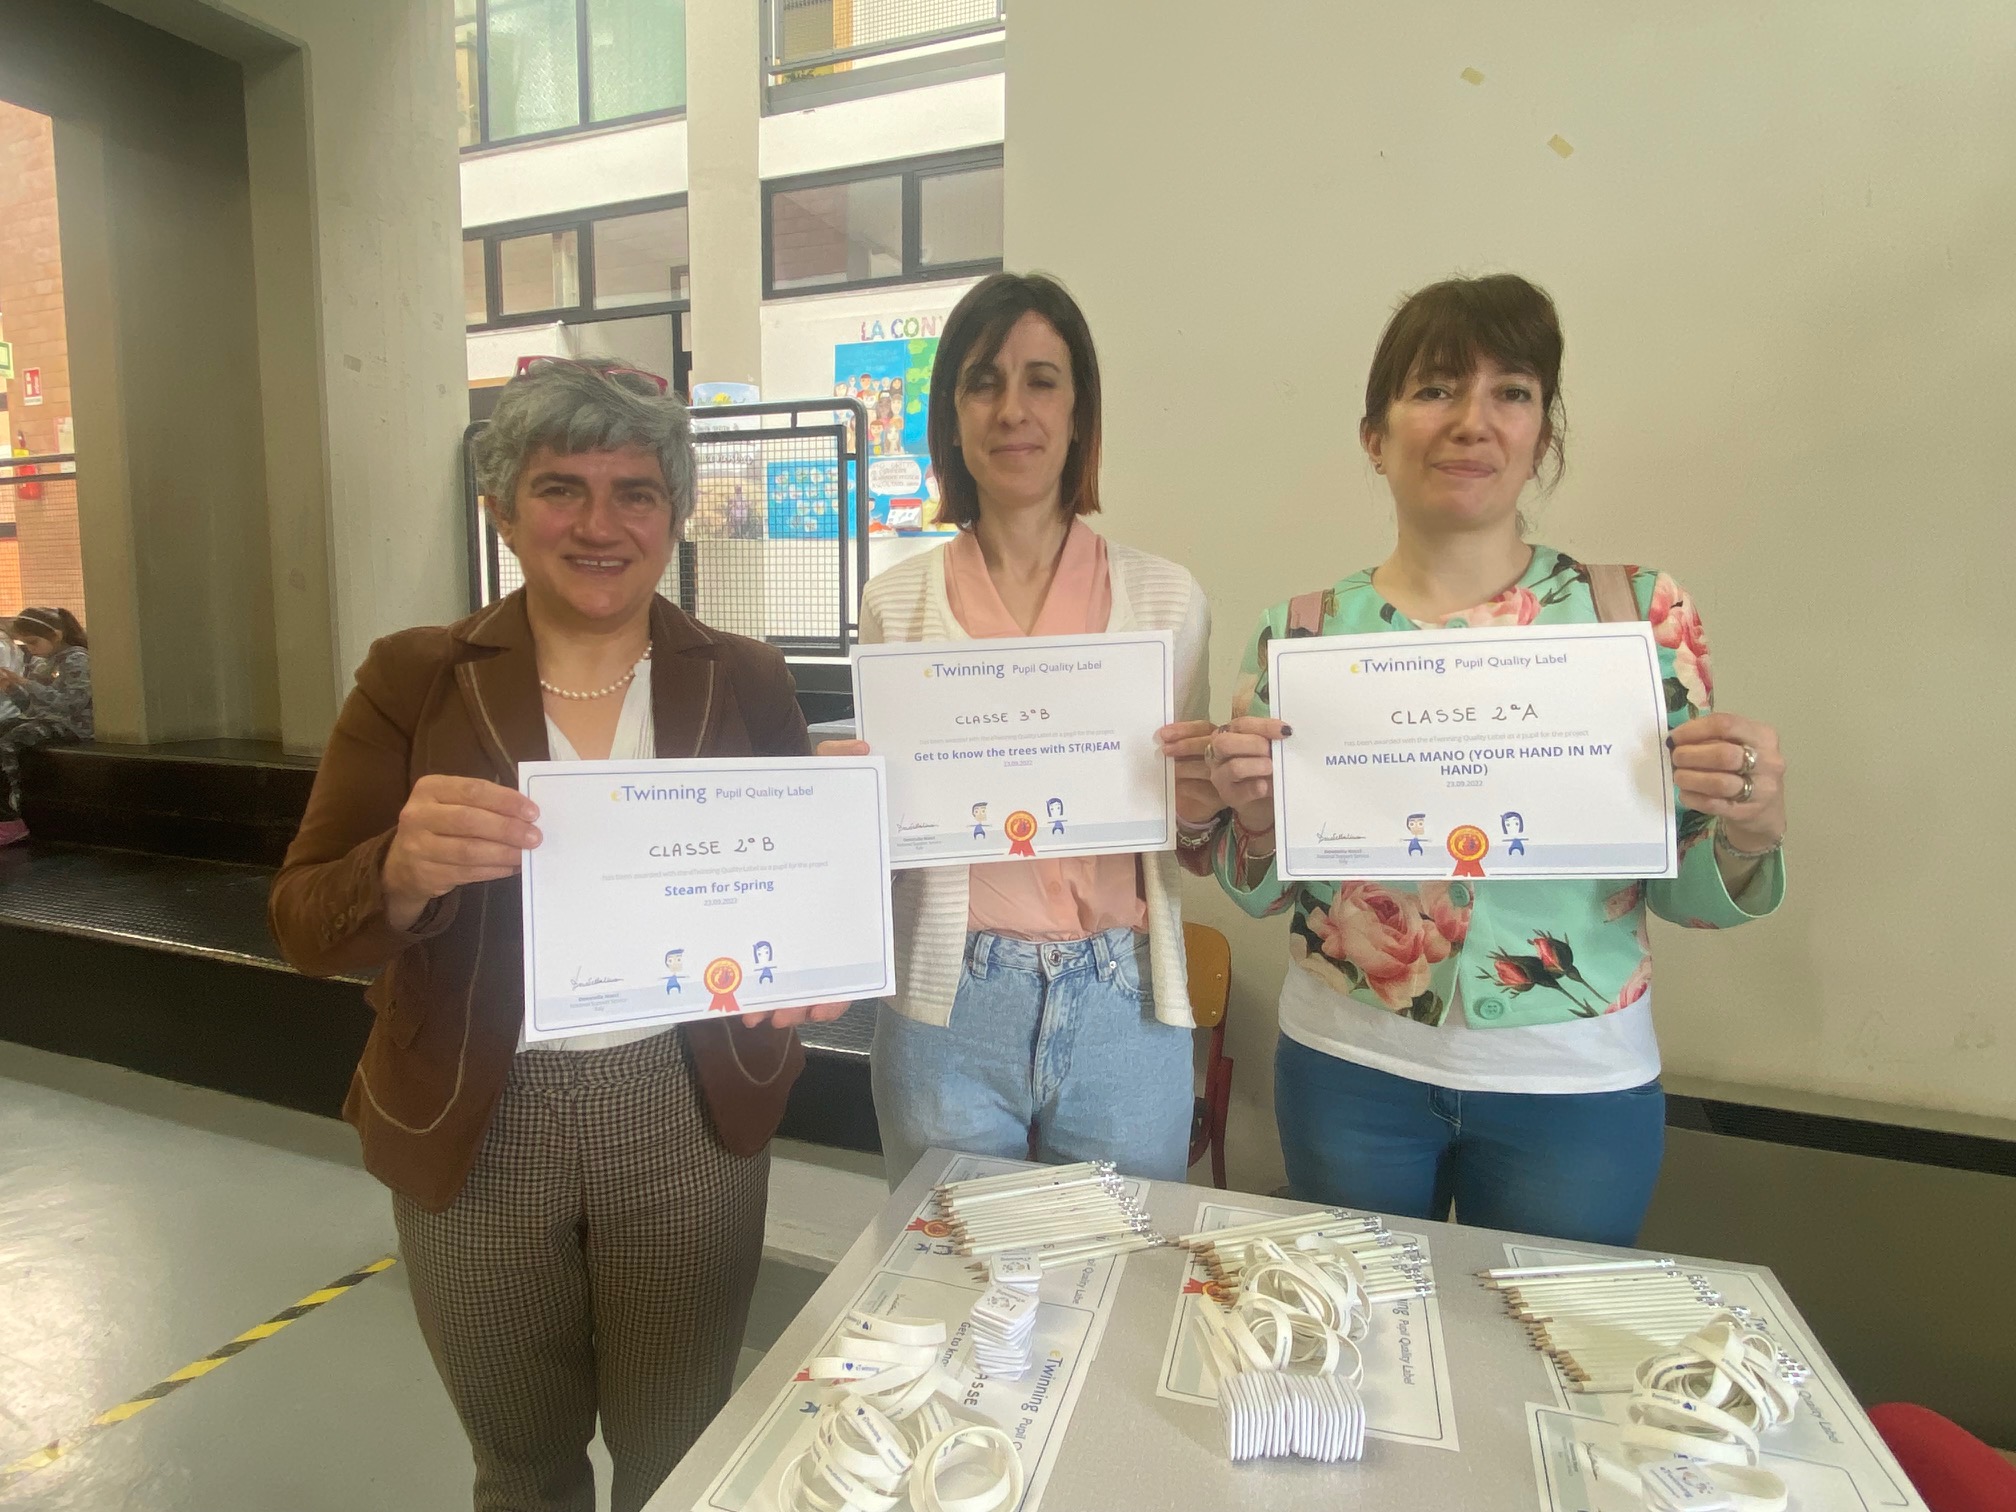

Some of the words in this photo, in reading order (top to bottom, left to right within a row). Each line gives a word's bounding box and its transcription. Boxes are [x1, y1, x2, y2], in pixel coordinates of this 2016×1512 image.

[861, 320, 885, 341] LA
[890, 315, 942, 338] CON
[923, 661, 1006, 679] eTwinning
[1012, 662, 1036, 675] Pupil
[1039, 661, 1074, 674] Quality
[1077, 660, 1102, 671] Label
[1351, 655, 1446, 674] eTwinning
[1455, 657, 1483, 669] Pupil
[1487, 655, 1531, 668] Quality
[1535, 653, 1567, 665] Label
[955, 712, 1009, 725] CLASSE
[1039, 708, 1051, 720] B
[1391, 707, 1477, 726] CLASSE
[1463, 733, 1487, 742] Quality
[1565, 729, 1589, 739] project
[914, 752, 934, 762] Get
[937, 751, 949, 761] to
[951, 748, 983, 760] know
[986, 747, 1005, 758] the
[1008, 746, 1038, 757] trees
[1040, 743, 1066, 755] with
[1068, 741, 1121, 755] ST(R)EAM
[1325, 755, 1368, 766] MANO
[1372, 752, 1415, 765] NELLA
[1420, 750, 1465, 763] MANO
[1469, 748, 1515, 762] (YOUR
[1519, 746, 1563, 758] HAND
[1568, 745, 1585, 756] IN
[1589, 744, 1613, 756] MY
[1440, 764, 1488, 777] HAND)
[610, 785, 707, 804] eTwinning
[715, 787, 742, 800] Pupil
[746, 786, 783, 799] Quality
[787, 785, 814, 796] Label
[649, 841, 721, 857] CLASSE
[762, 836, 775, 852] B
[665, 884, 707, 896] Steam
[711, 881, 729, 893] for
[733, 880, 774, 893] Spring
[960, 1321, 971, 1337] Get
[951, 1337, 963, 1347] to
[942, 1348, 959, 1367] kno
[1021, 1350, 1064, 1414] eTwinning
[1402, 1365, 1416, 1386] Label
[1015, 1417, 1033, 1440] Pupil
